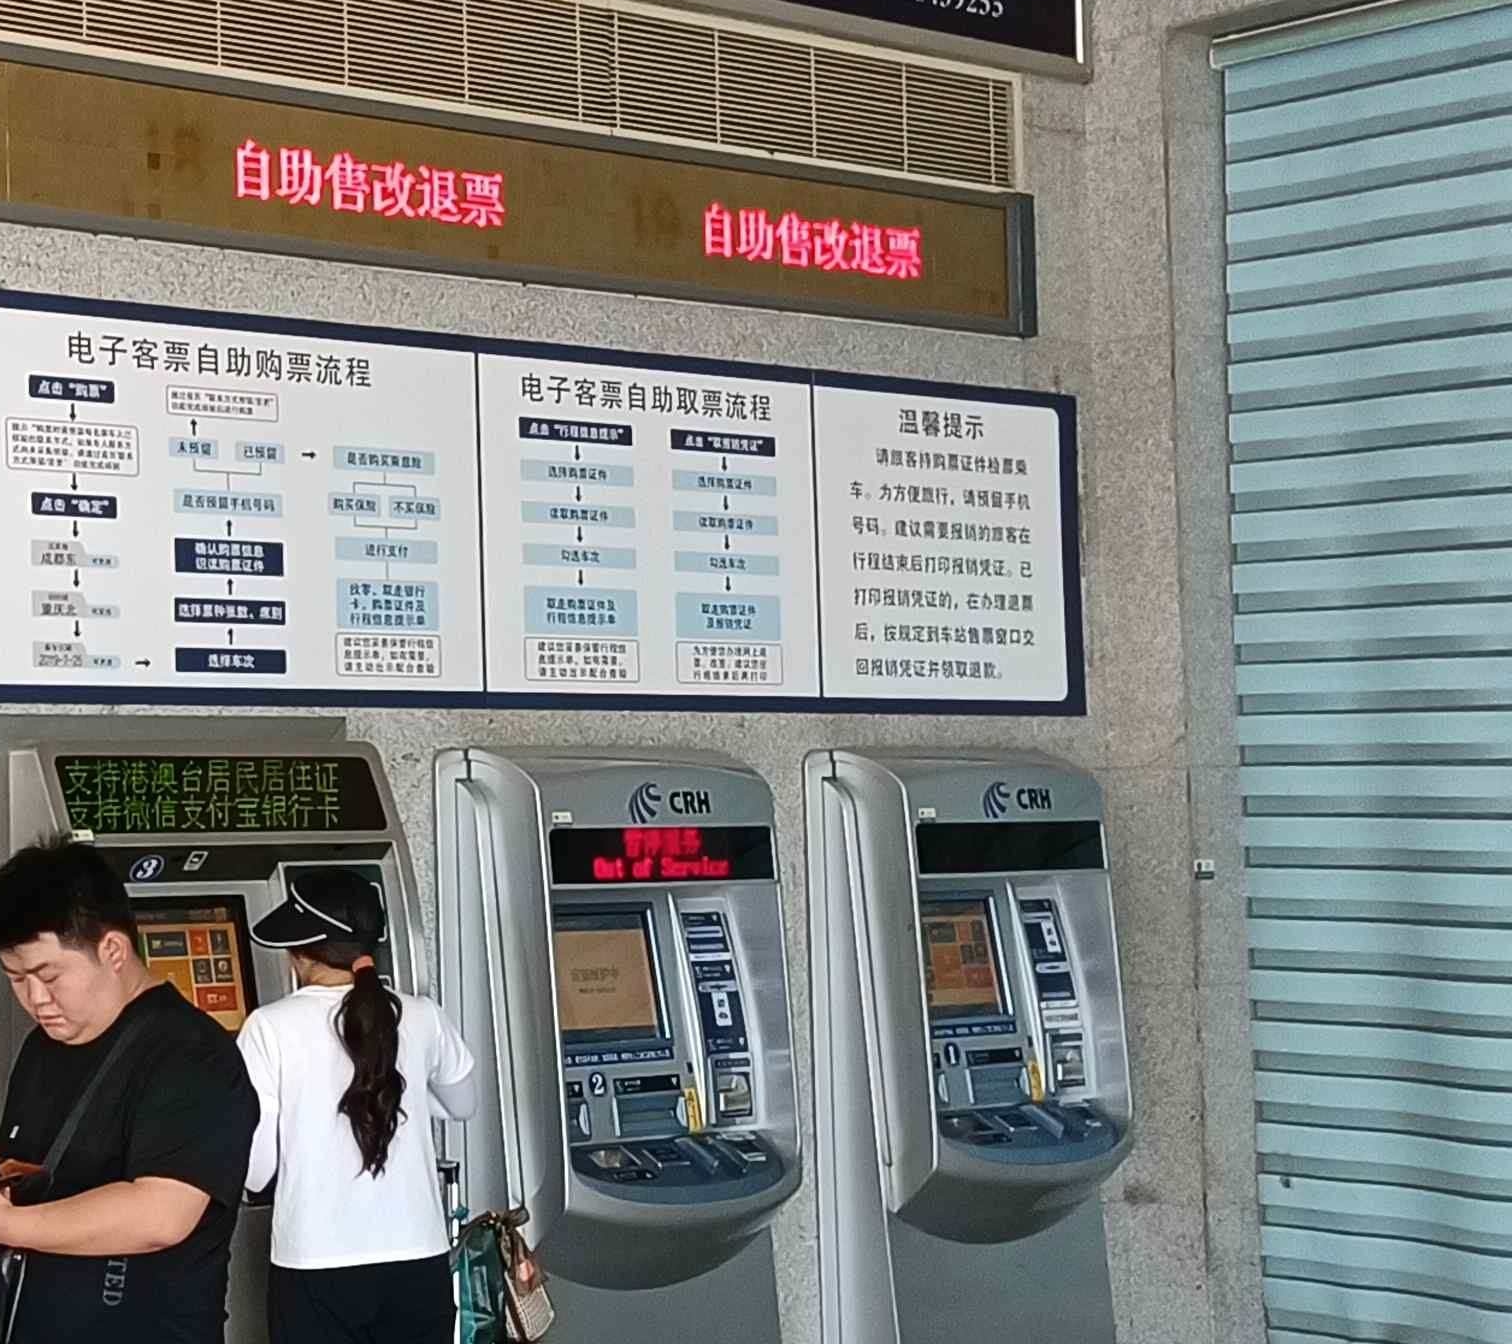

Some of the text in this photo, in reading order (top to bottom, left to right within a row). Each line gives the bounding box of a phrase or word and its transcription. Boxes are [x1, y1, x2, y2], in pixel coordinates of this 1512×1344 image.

[232, 138, 506, 229] 自助售改退票
[701, 200, 924, 281] 自助售改退票
[66, 330, 373, 388] 电子客票自助购票流程
[520, 373, 773, 423] 电子客票自助取票流程
[899, 408, 984, 440] 温馨提示
[65, 759, 340, 796] 支持港澳台居民居住证
[69, 794, 341, 830] 支持微信支付宝银行卡
[668, 790, 712, 815] CRH
[1016, 788, 1052, 809] CRH
[591, 1074, 605, 1095] 2
